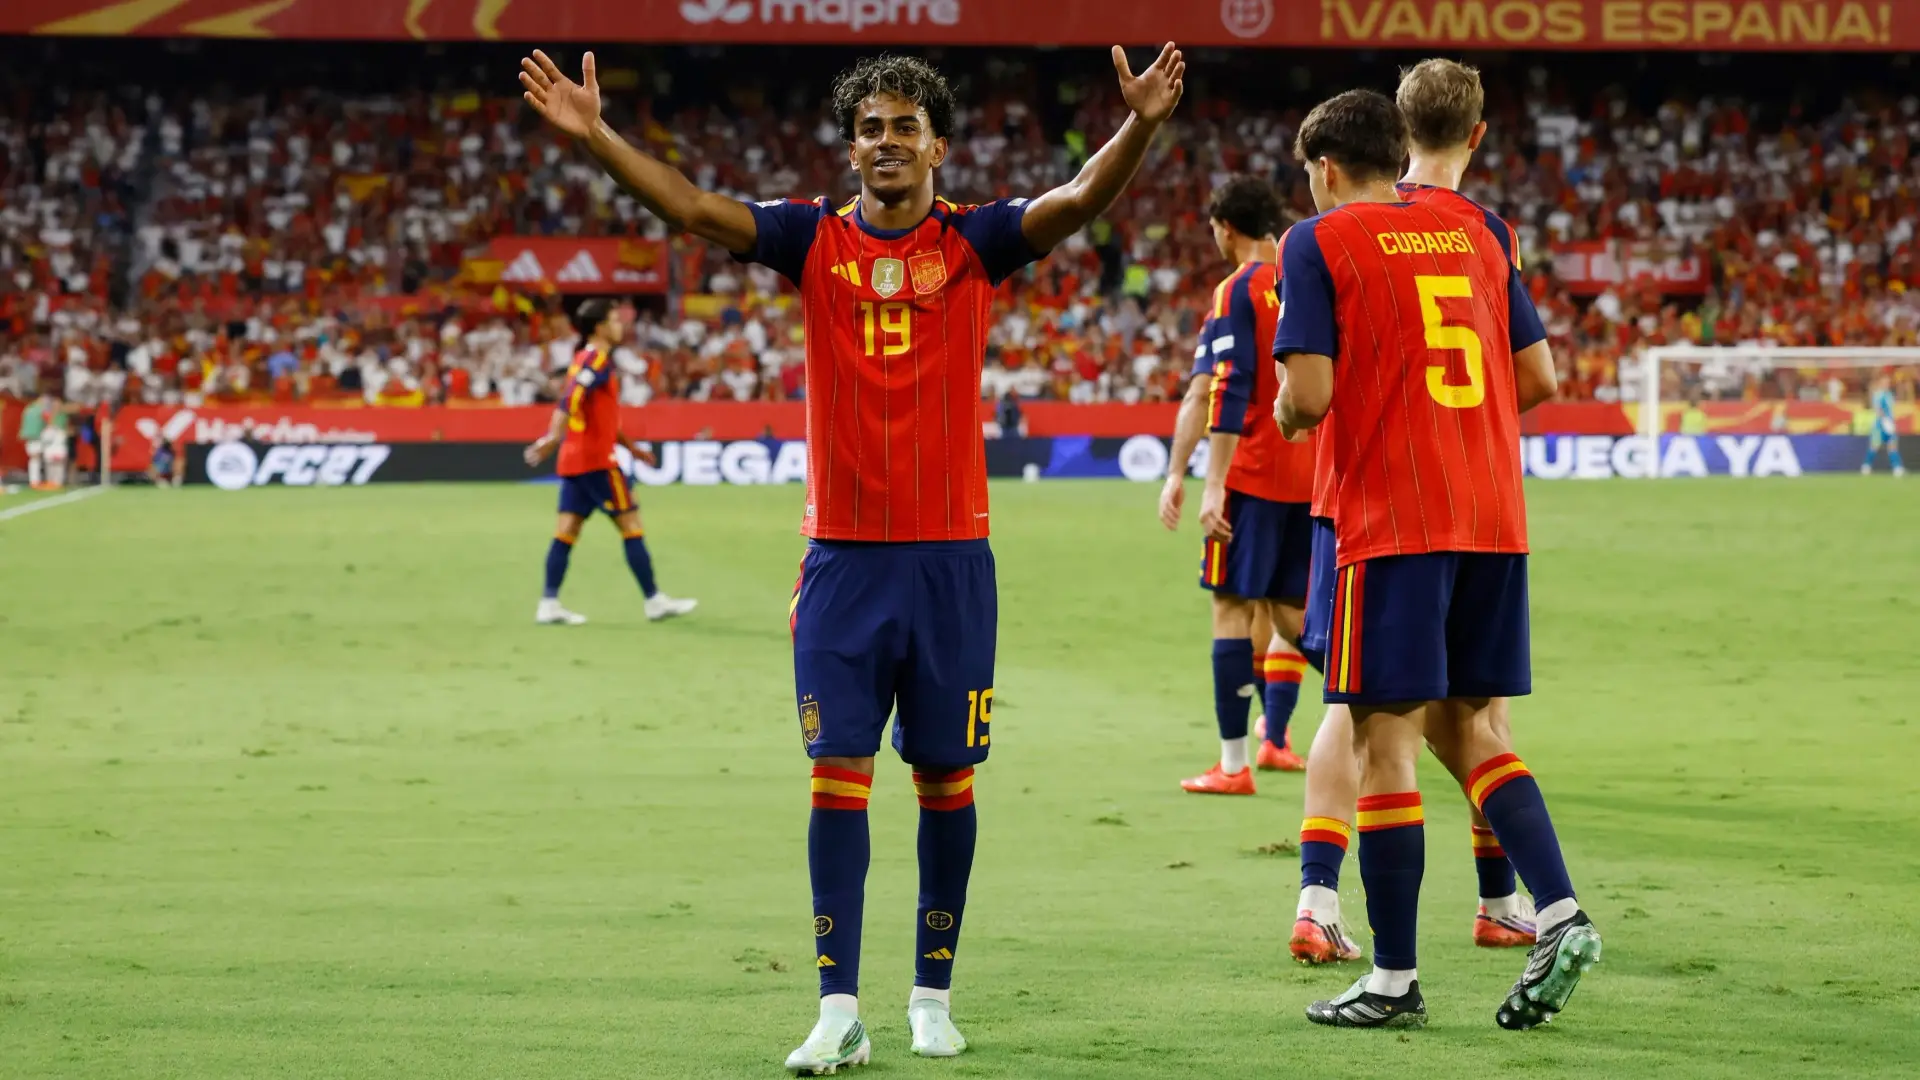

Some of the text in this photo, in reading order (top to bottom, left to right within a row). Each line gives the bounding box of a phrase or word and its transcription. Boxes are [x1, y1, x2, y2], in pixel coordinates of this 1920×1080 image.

[1320, 0, 1586, 42] ¡VAMOS
[861, 301, 911, 356] 19
[1414, 275, 1485, 408] 5
[1520, 435, 1801, 479] UEGA YA
[966, 688, 993, 747] 19
